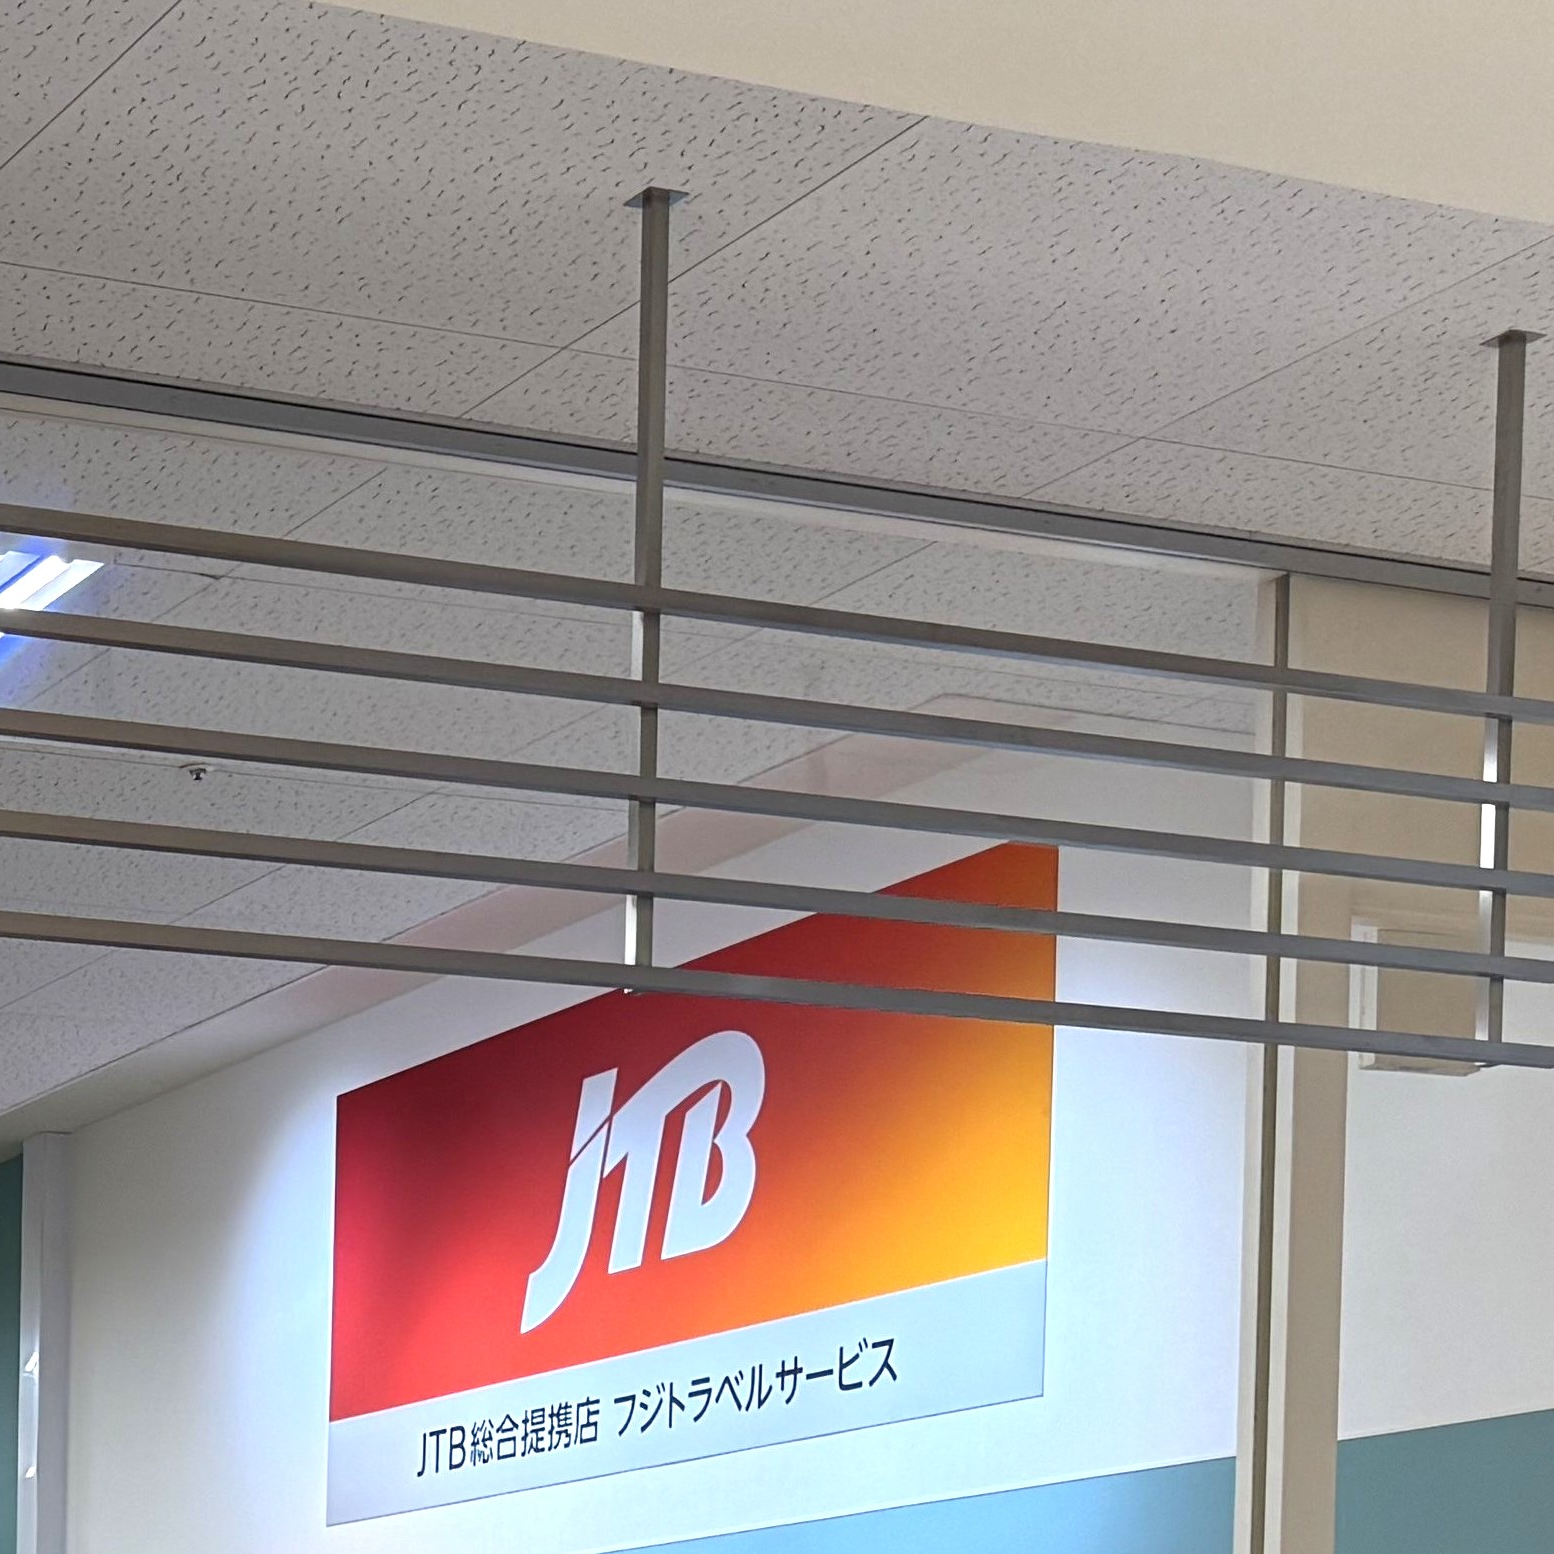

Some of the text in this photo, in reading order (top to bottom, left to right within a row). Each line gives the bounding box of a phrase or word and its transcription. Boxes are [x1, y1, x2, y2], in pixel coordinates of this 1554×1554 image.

[520, 1030, 766, 1335] JTB
[417, 1337, 898, 1478] JTB総合提携店 フジトラベルサービス
